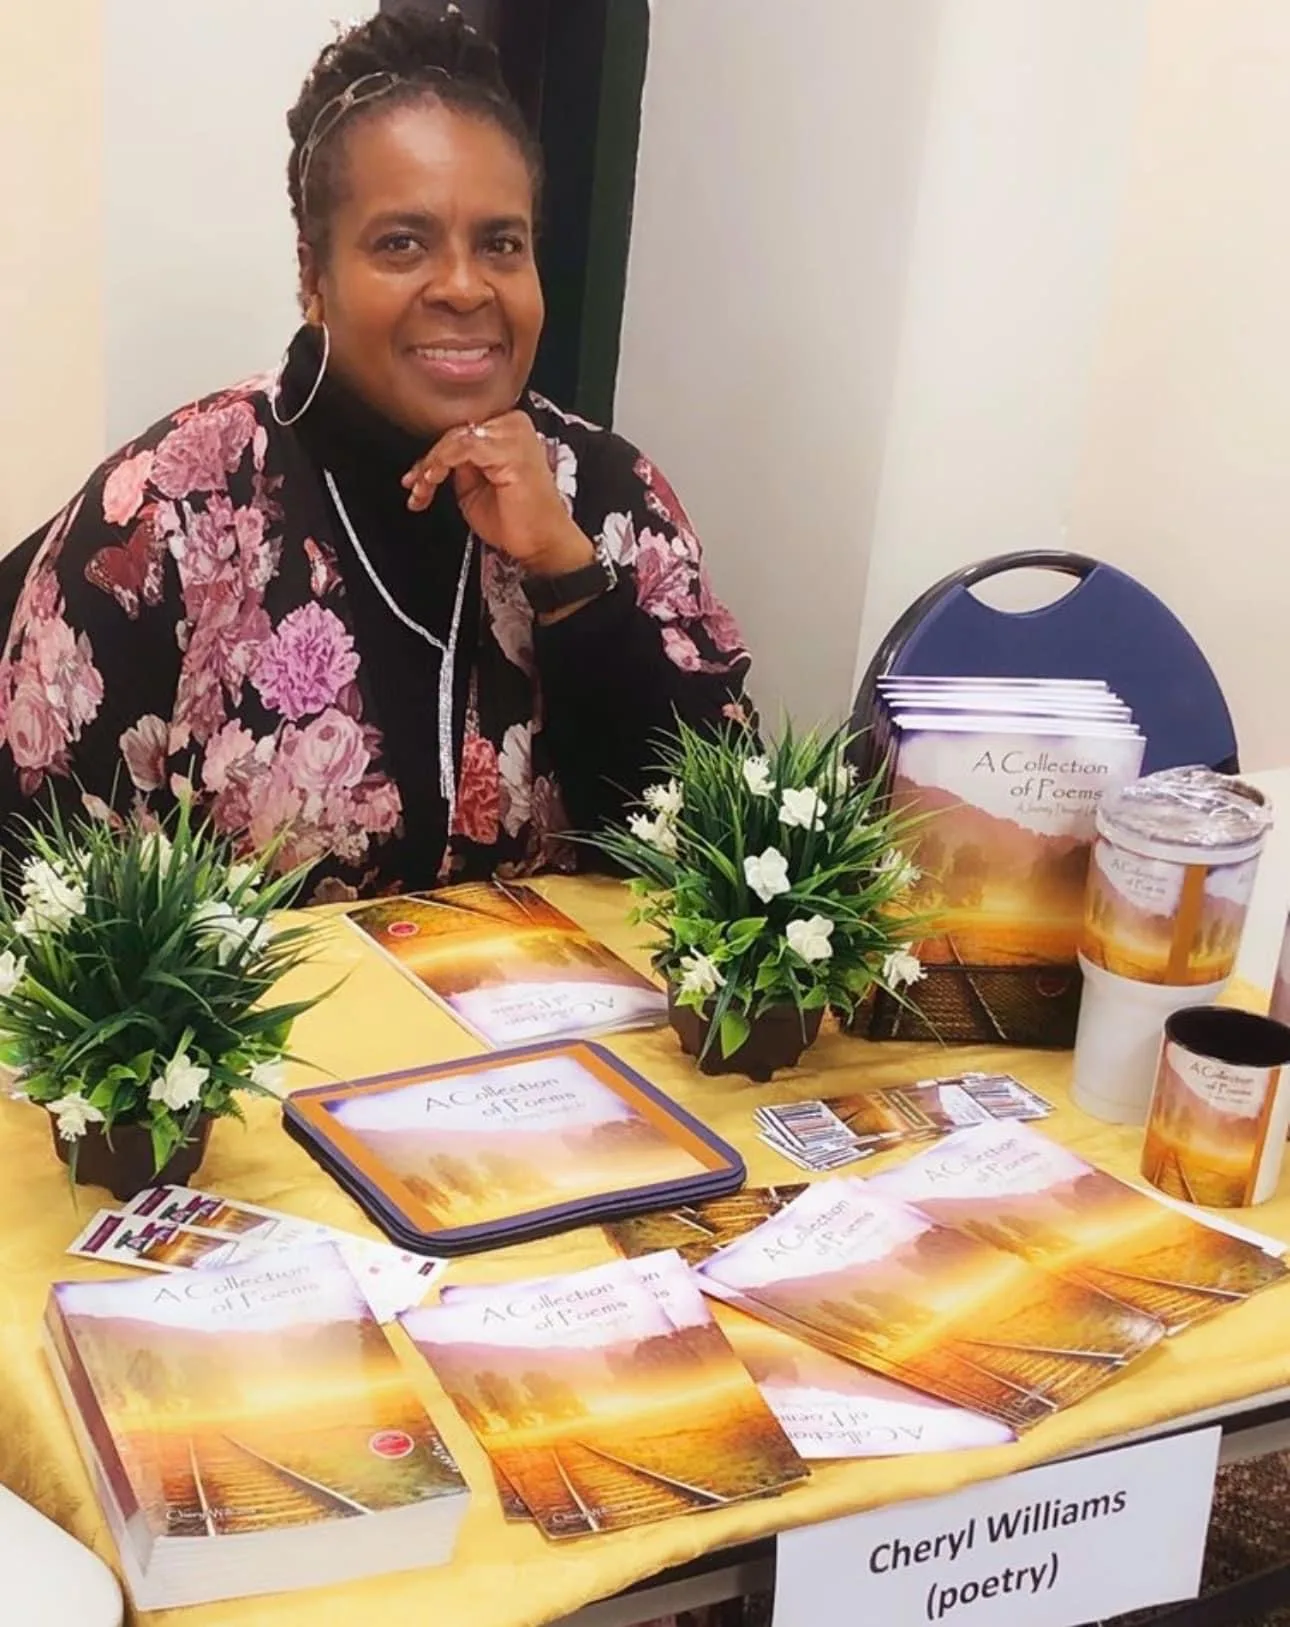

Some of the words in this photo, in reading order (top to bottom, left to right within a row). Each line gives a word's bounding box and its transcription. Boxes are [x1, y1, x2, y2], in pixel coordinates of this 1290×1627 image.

[972, 751, 996, 773] A
[1001, 750, 1109, 774] Collection
[1010, 778, 1034, 797] of
[1037, 778, 1105, 801] Poems
[1189, 1061, 1200, 1075] A
[426, 1096, 451, 1113] A
[449, 1077, 559, 1106] Collection
[481, 1101, 502, 1117] of
[503, 1091, 577, 1113] Poems
[924, 1168, 951, 1182] A
[940, 1138, 1018, 1176] Collection
[777, 1198, 851, 1250] Collection
[821, 1210, 875, 1246] Poems
[762, 1246, 793, 1262] A
[152, 1286, 183, 1303] A
[184, 1264, 311, 1300] Collection
[211, 1297, 233, 1316] of
[240, 1281, 321, 1309] Poems
[482, 1305, 507, 1326] A
[506, 1282, 616, 1319] Collection
[534, 1314, 556, 1332] of
[557, 1300, 629, 1327] Poems
[780, 1411, 845, 1428] Poem
[848, 1411, 870, 1427] of
[897, 1424, 924, 1440] A
[868, 1518, 976, 1575] Cheryl
[986, 1490, 1127, 1544] Williams
[926, 1552, 1060, 1621] (poetry)
